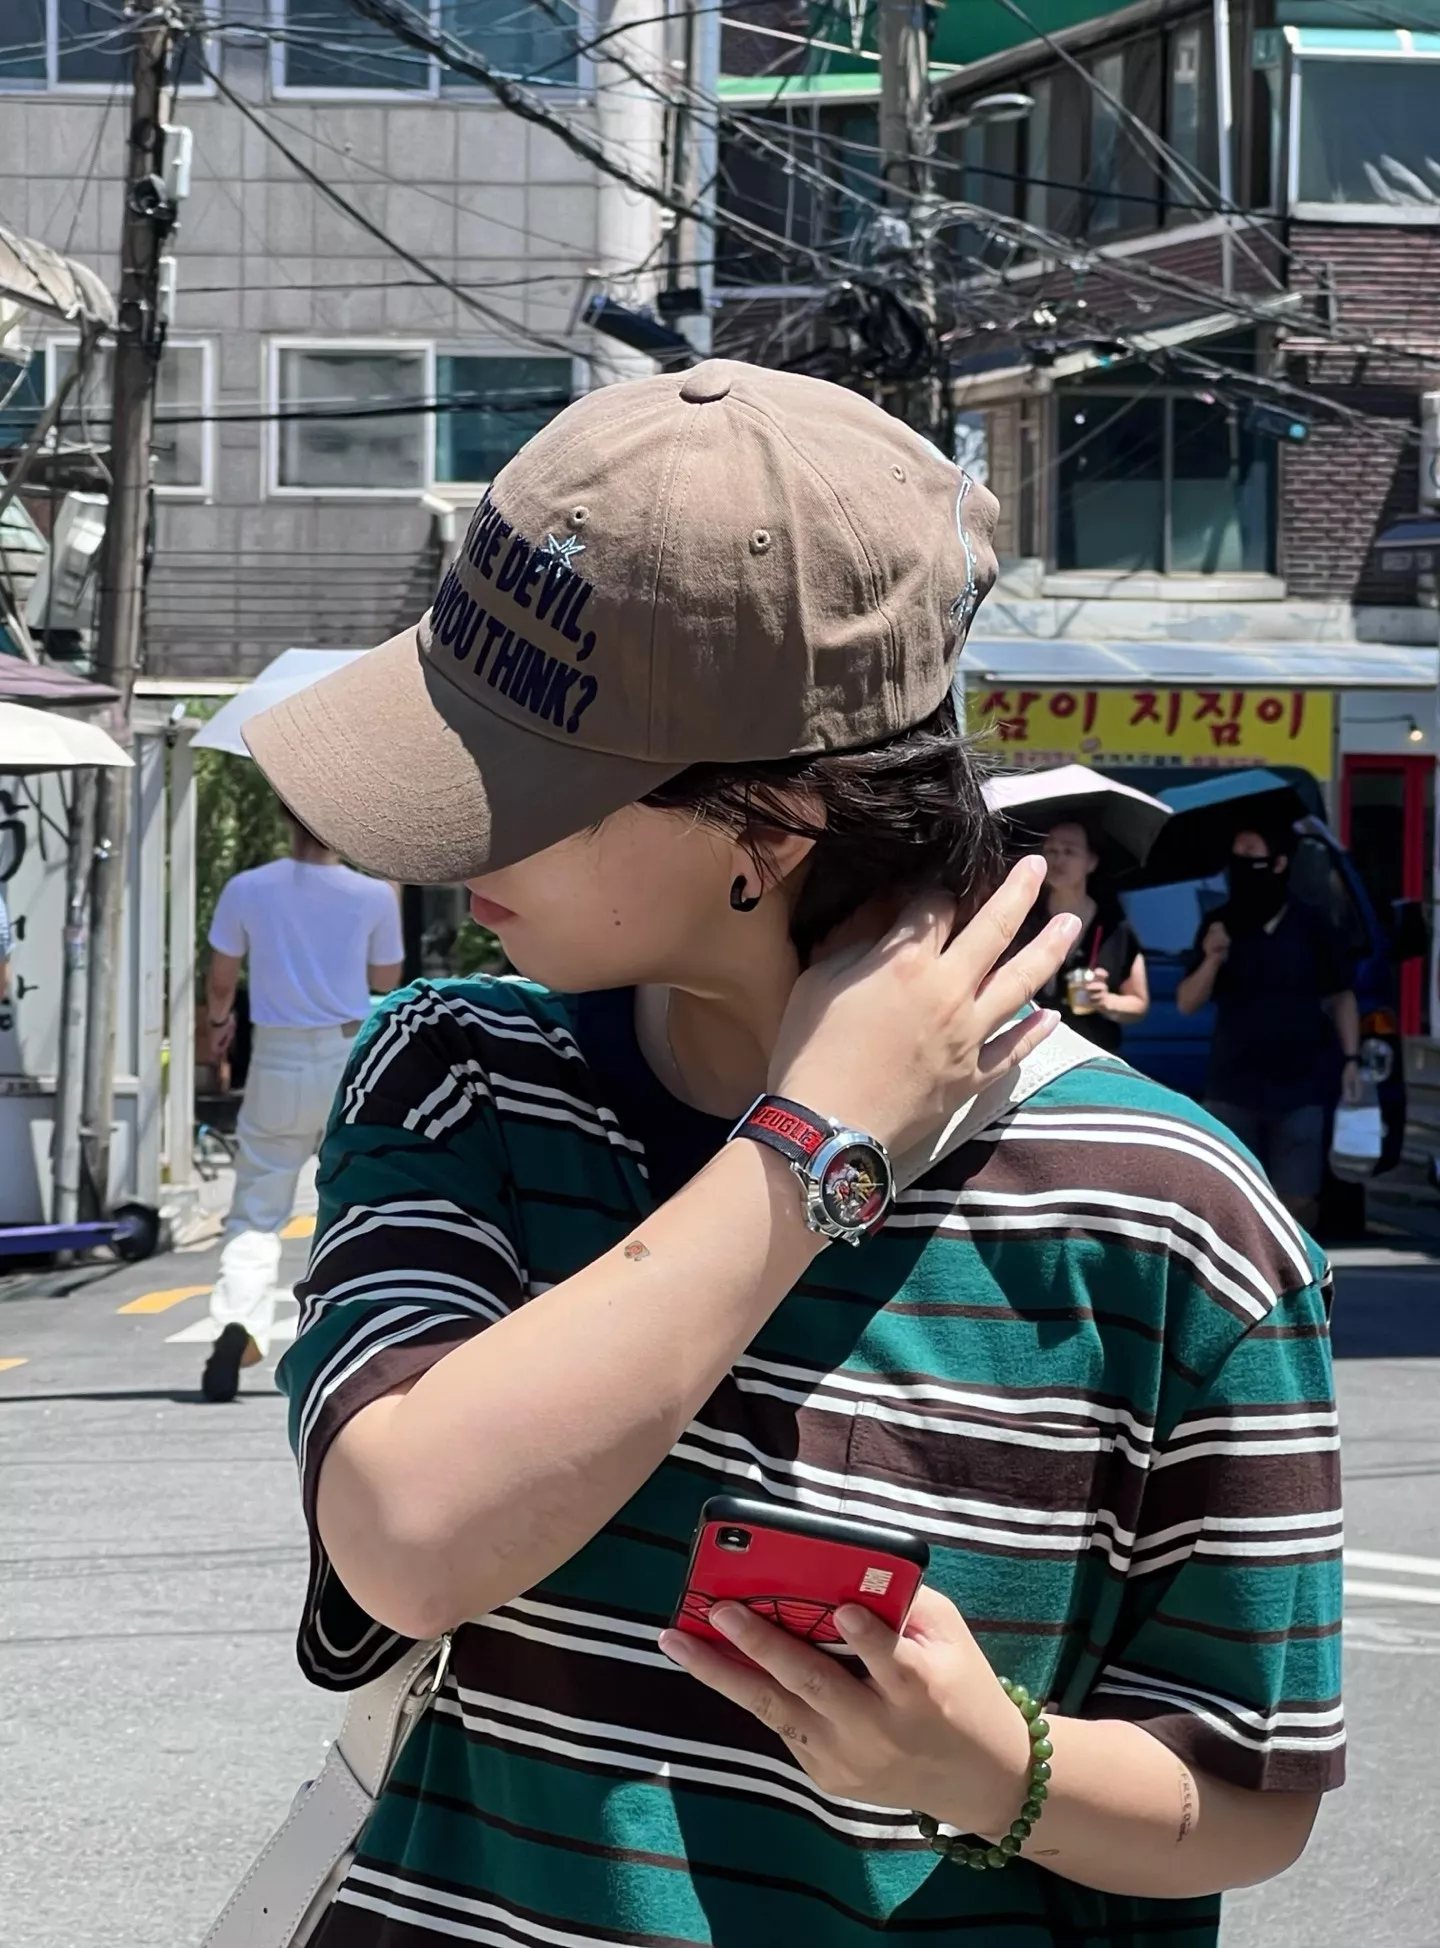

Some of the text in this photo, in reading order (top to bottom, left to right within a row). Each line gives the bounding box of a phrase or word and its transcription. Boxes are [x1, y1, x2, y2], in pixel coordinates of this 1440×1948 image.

[434, 576, 487, 660] YOU
[473, 616, 598, 733] THINK?
[496, 532, 597, 662] DEVIL,
